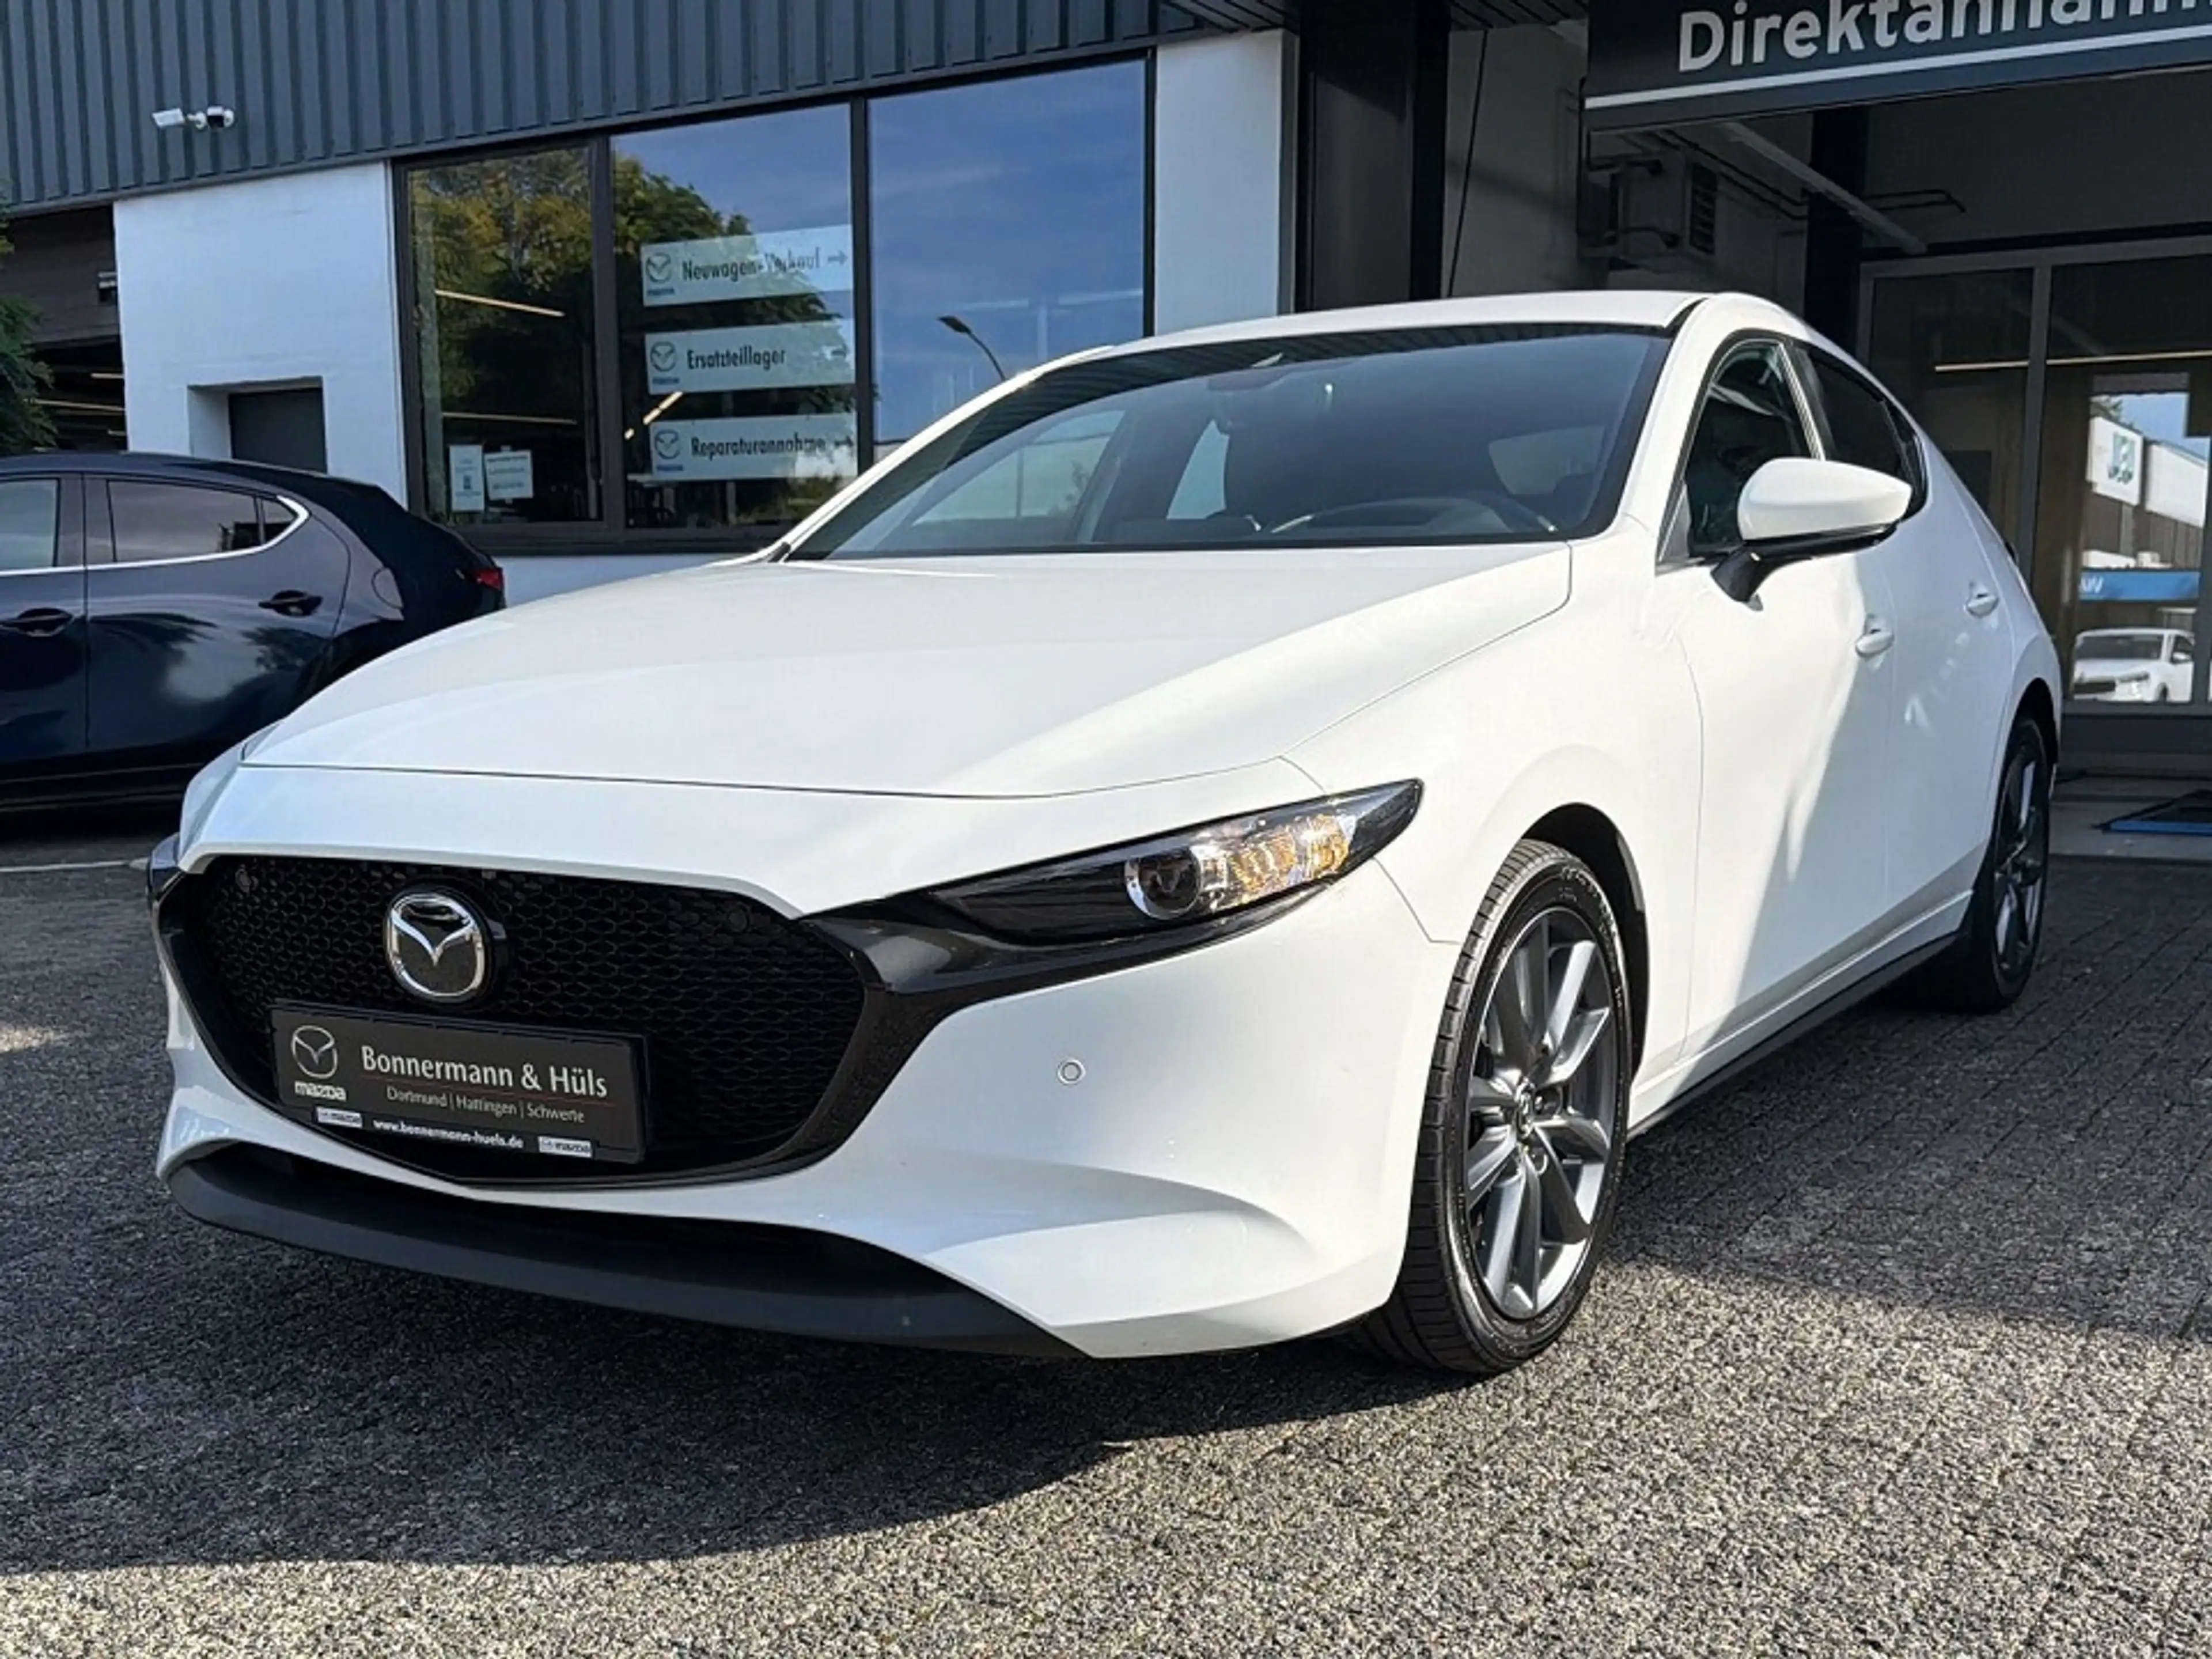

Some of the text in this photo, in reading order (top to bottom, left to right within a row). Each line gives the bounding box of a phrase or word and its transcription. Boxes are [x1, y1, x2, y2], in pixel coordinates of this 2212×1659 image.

[1679, 0, 2212, 71] Direktanna
[687, 344, 786, 372] Ersatzteillager
[691, 431, 825, 461] Reparaturannahme
[361, 1044, 608, 1098] Bonnermann & Hüls
[387, 1085, 585, 1123] Dortmund Hattingen Schwerte
[373, 1119, 524, 1149] www.bonnermann-huels.de
